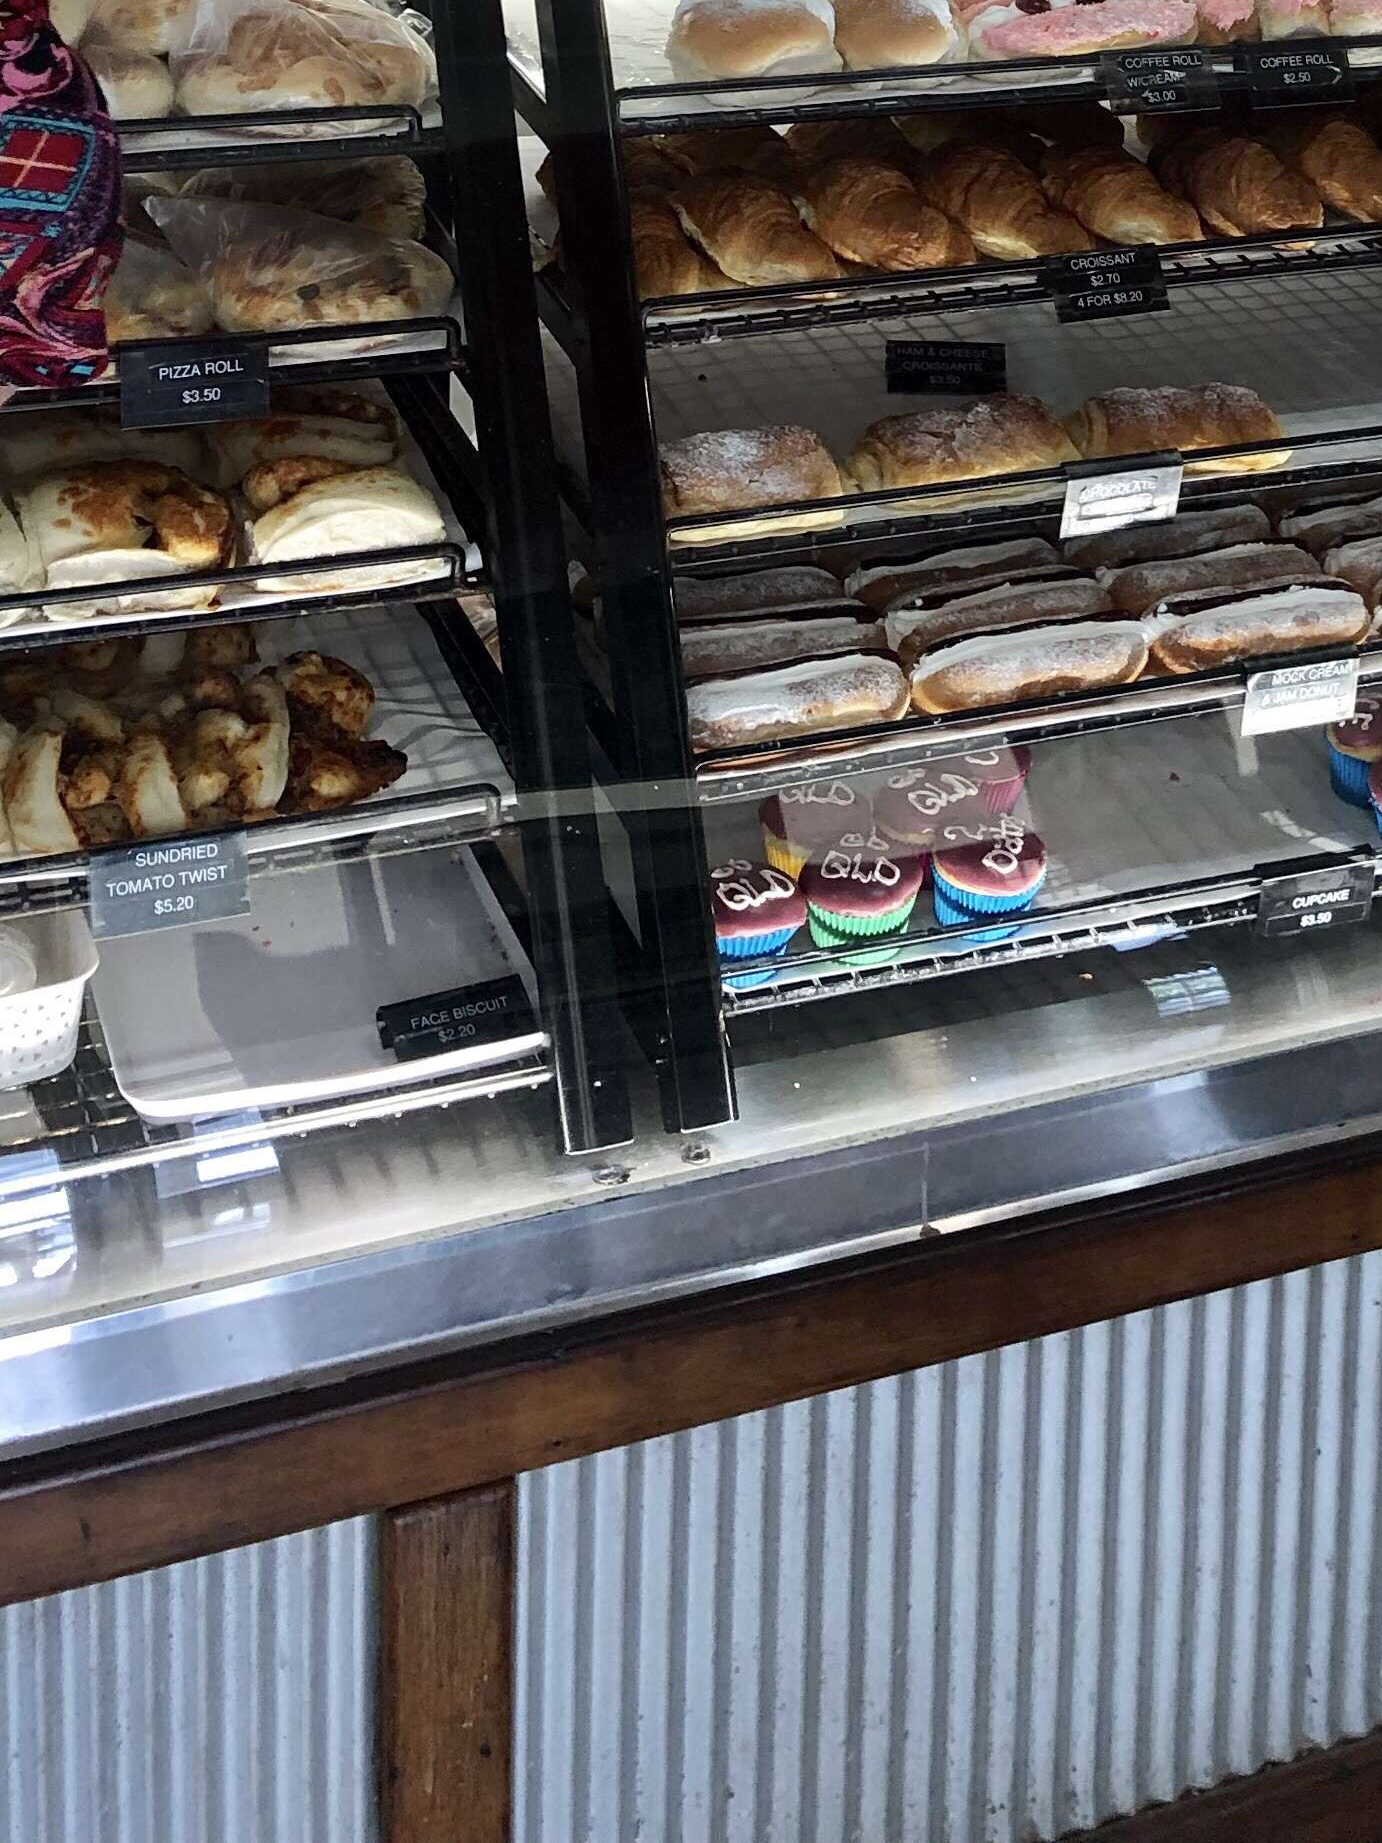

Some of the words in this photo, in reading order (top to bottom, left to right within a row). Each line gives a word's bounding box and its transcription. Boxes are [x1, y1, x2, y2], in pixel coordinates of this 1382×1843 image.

[1125, 57, 1170, 70] COFFEE
[1173, 55, 1201, 66] ROLL
[1260, 57, 1305, 69] COFFEE
[1307, 54, 1334, 65] ROLL
[1283, 72, 1311, 85] $2.50
[1148, 90, 1176, 103] $3.00
[1070, 252, 1136, 271] CROISSANT
[1090, 272, 1121, 288] $2.70
[1077, 297, 1085, 308] 4
[1086, 294, 1112, 307] FOR
[159, 364, 201, 381] PIZZA
[204, 359, 244, 375] ROLL
[182, 387, 221, 404] $3.50
[1272, 671, 1306, 686] MOCK
[1308, 663, 1352, 680] CREAM
[135, 843, 218, 867] SUNDRIED
[106, 874, 175, 897] TOMATO
[178, 865, 228, 885] TWIST
[154, 896, 194, 915] $5.20
[1292, 889, 1351, 909] CUPCAKE
[410, 1012, 450, 1029] FACE
[452, 996, 508, 1020] BISCUIT
[438, 1024, 476, 1043] $2.20
